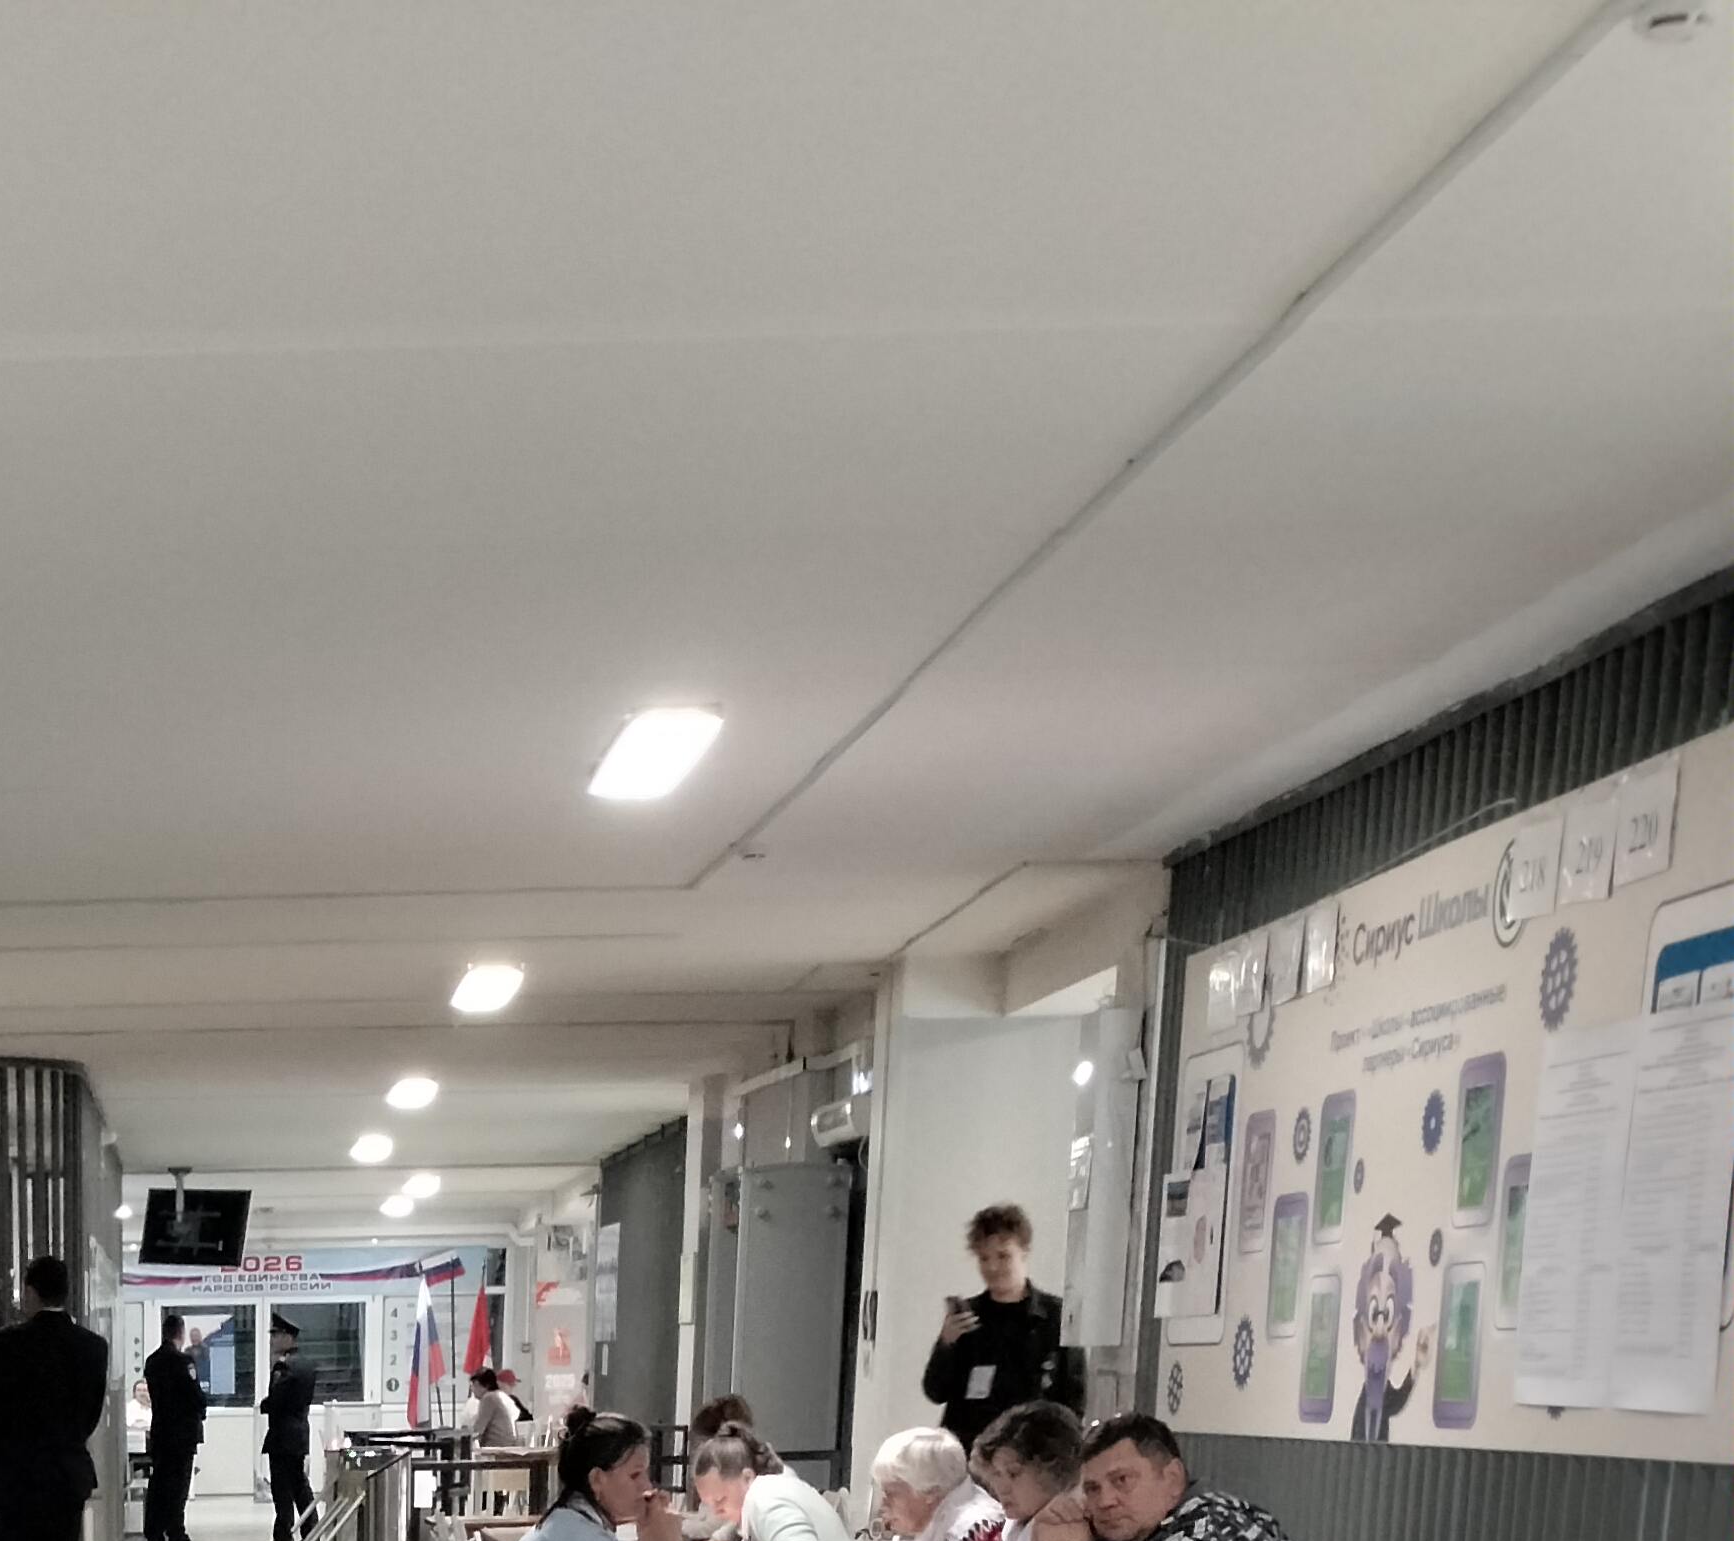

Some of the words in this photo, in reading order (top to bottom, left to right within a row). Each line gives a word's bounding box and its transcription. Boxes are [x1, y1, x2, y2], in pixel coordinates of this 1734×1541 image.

[1629, 811, 1659, 854] 220
[1575, 836, 1604, 875] 219
[1519, 857, 1547, 893] 218
[1353, 913, 1416, 969] Сириус
[1418, 883, 1491, 941] Школы
[221, 1255, 302, 1273] 026
[204, 1274, 233, 1283] ГОД
[238, 1273, 320, 1283] ЕДИНСТВА
[192, 1283, 264, 1293] НАРОДОВ
[269, 1282, 332, 1292] РОССИИ
[390, 1307, 398, 1318] 4
[390, 1330, 398, 1341] 3
[389, 1354, 398, 1366] 2
